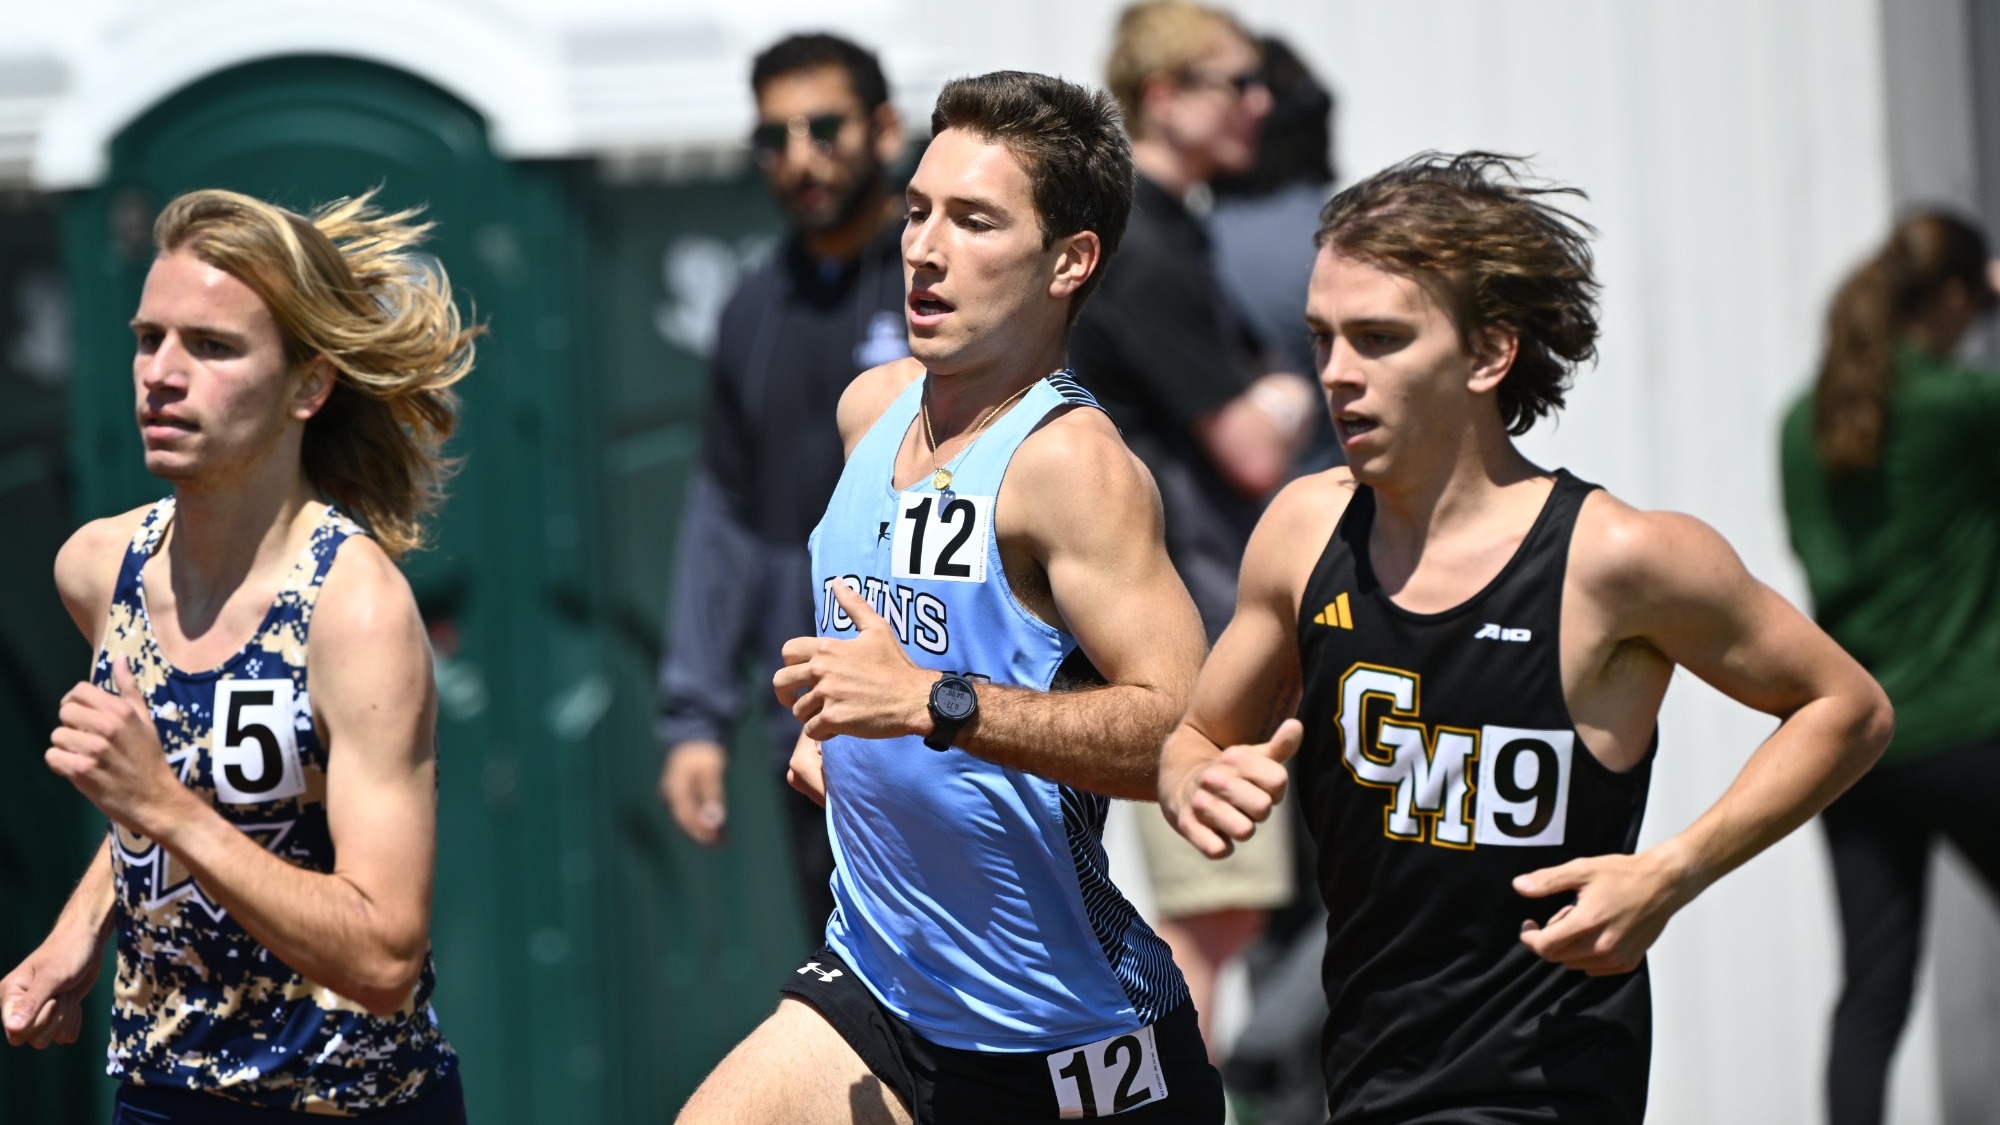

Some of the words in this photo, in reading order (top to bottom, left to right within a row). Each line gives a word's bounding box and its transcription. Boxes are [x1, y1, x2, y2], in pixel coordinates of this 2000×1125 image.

[905, 497, 976, 577] 12
[224, 690, 283, 793] 5
[1334, 661, 1480, 851] GM
[1493, 738, 1559, 839] 9
[1058, 1034, 1152, 1118] 12
